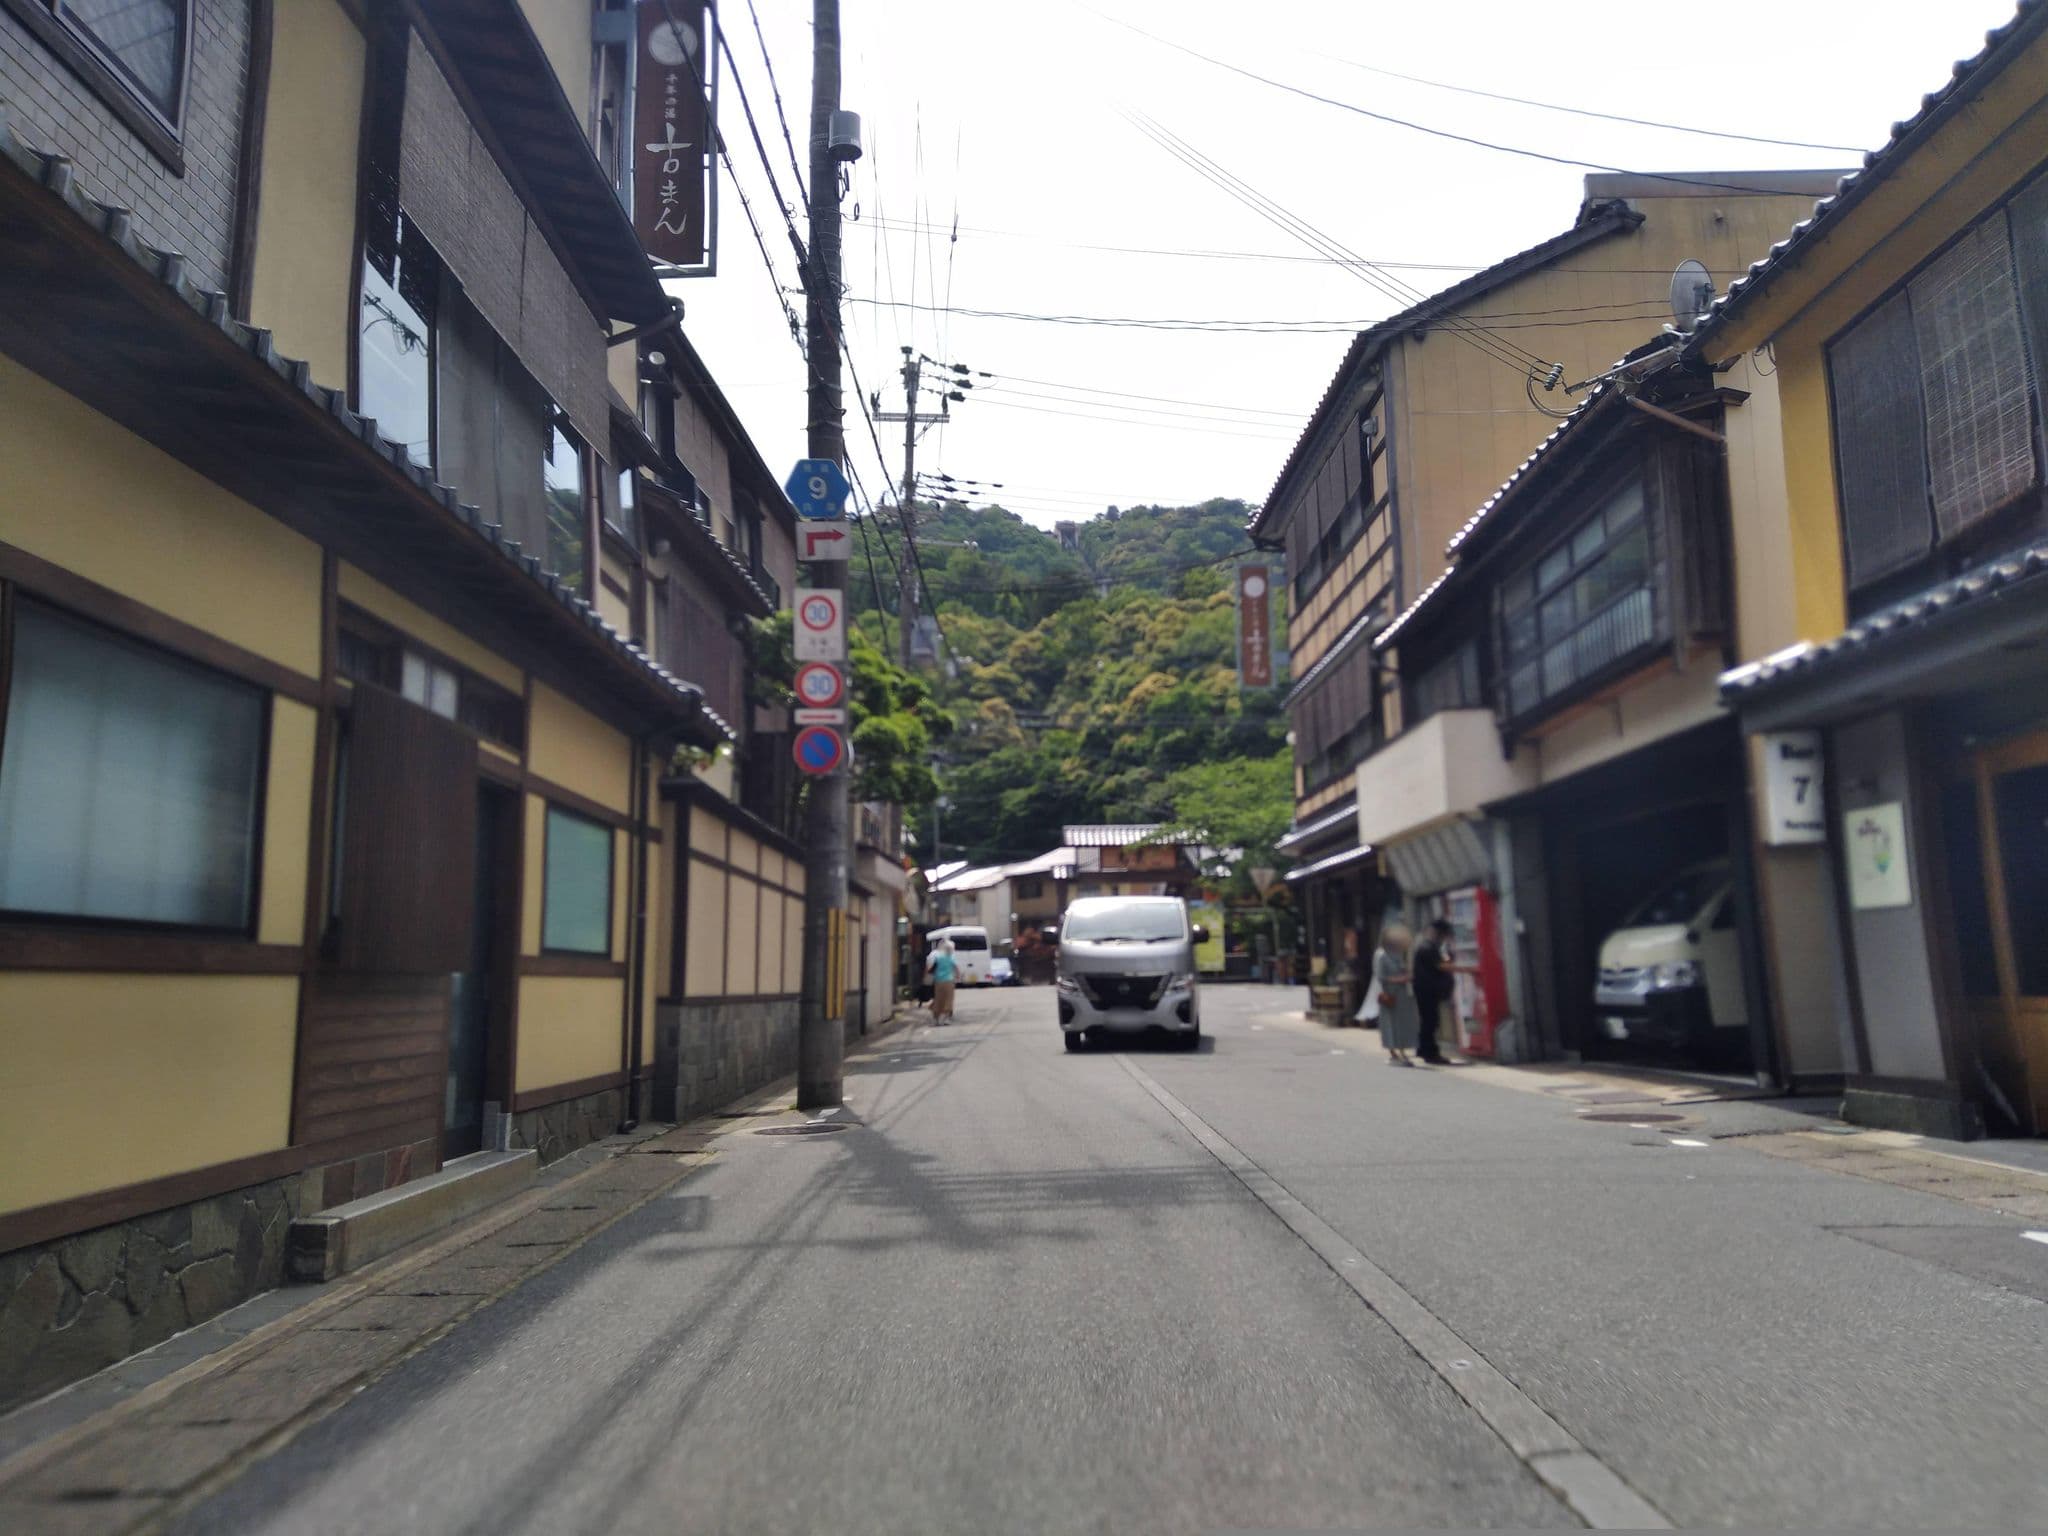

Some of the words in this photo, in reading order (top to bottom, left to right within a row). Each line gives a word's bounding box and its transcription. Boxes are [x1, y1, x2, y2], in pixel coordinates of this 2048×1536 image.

[645, 122, 693, 236] 古まん
[807, 475, 828, 500] 9
[807, 603, 829, 622] 30
[806, 674, 833, 696] 30
[1791, 775, 1811, 805] 7
